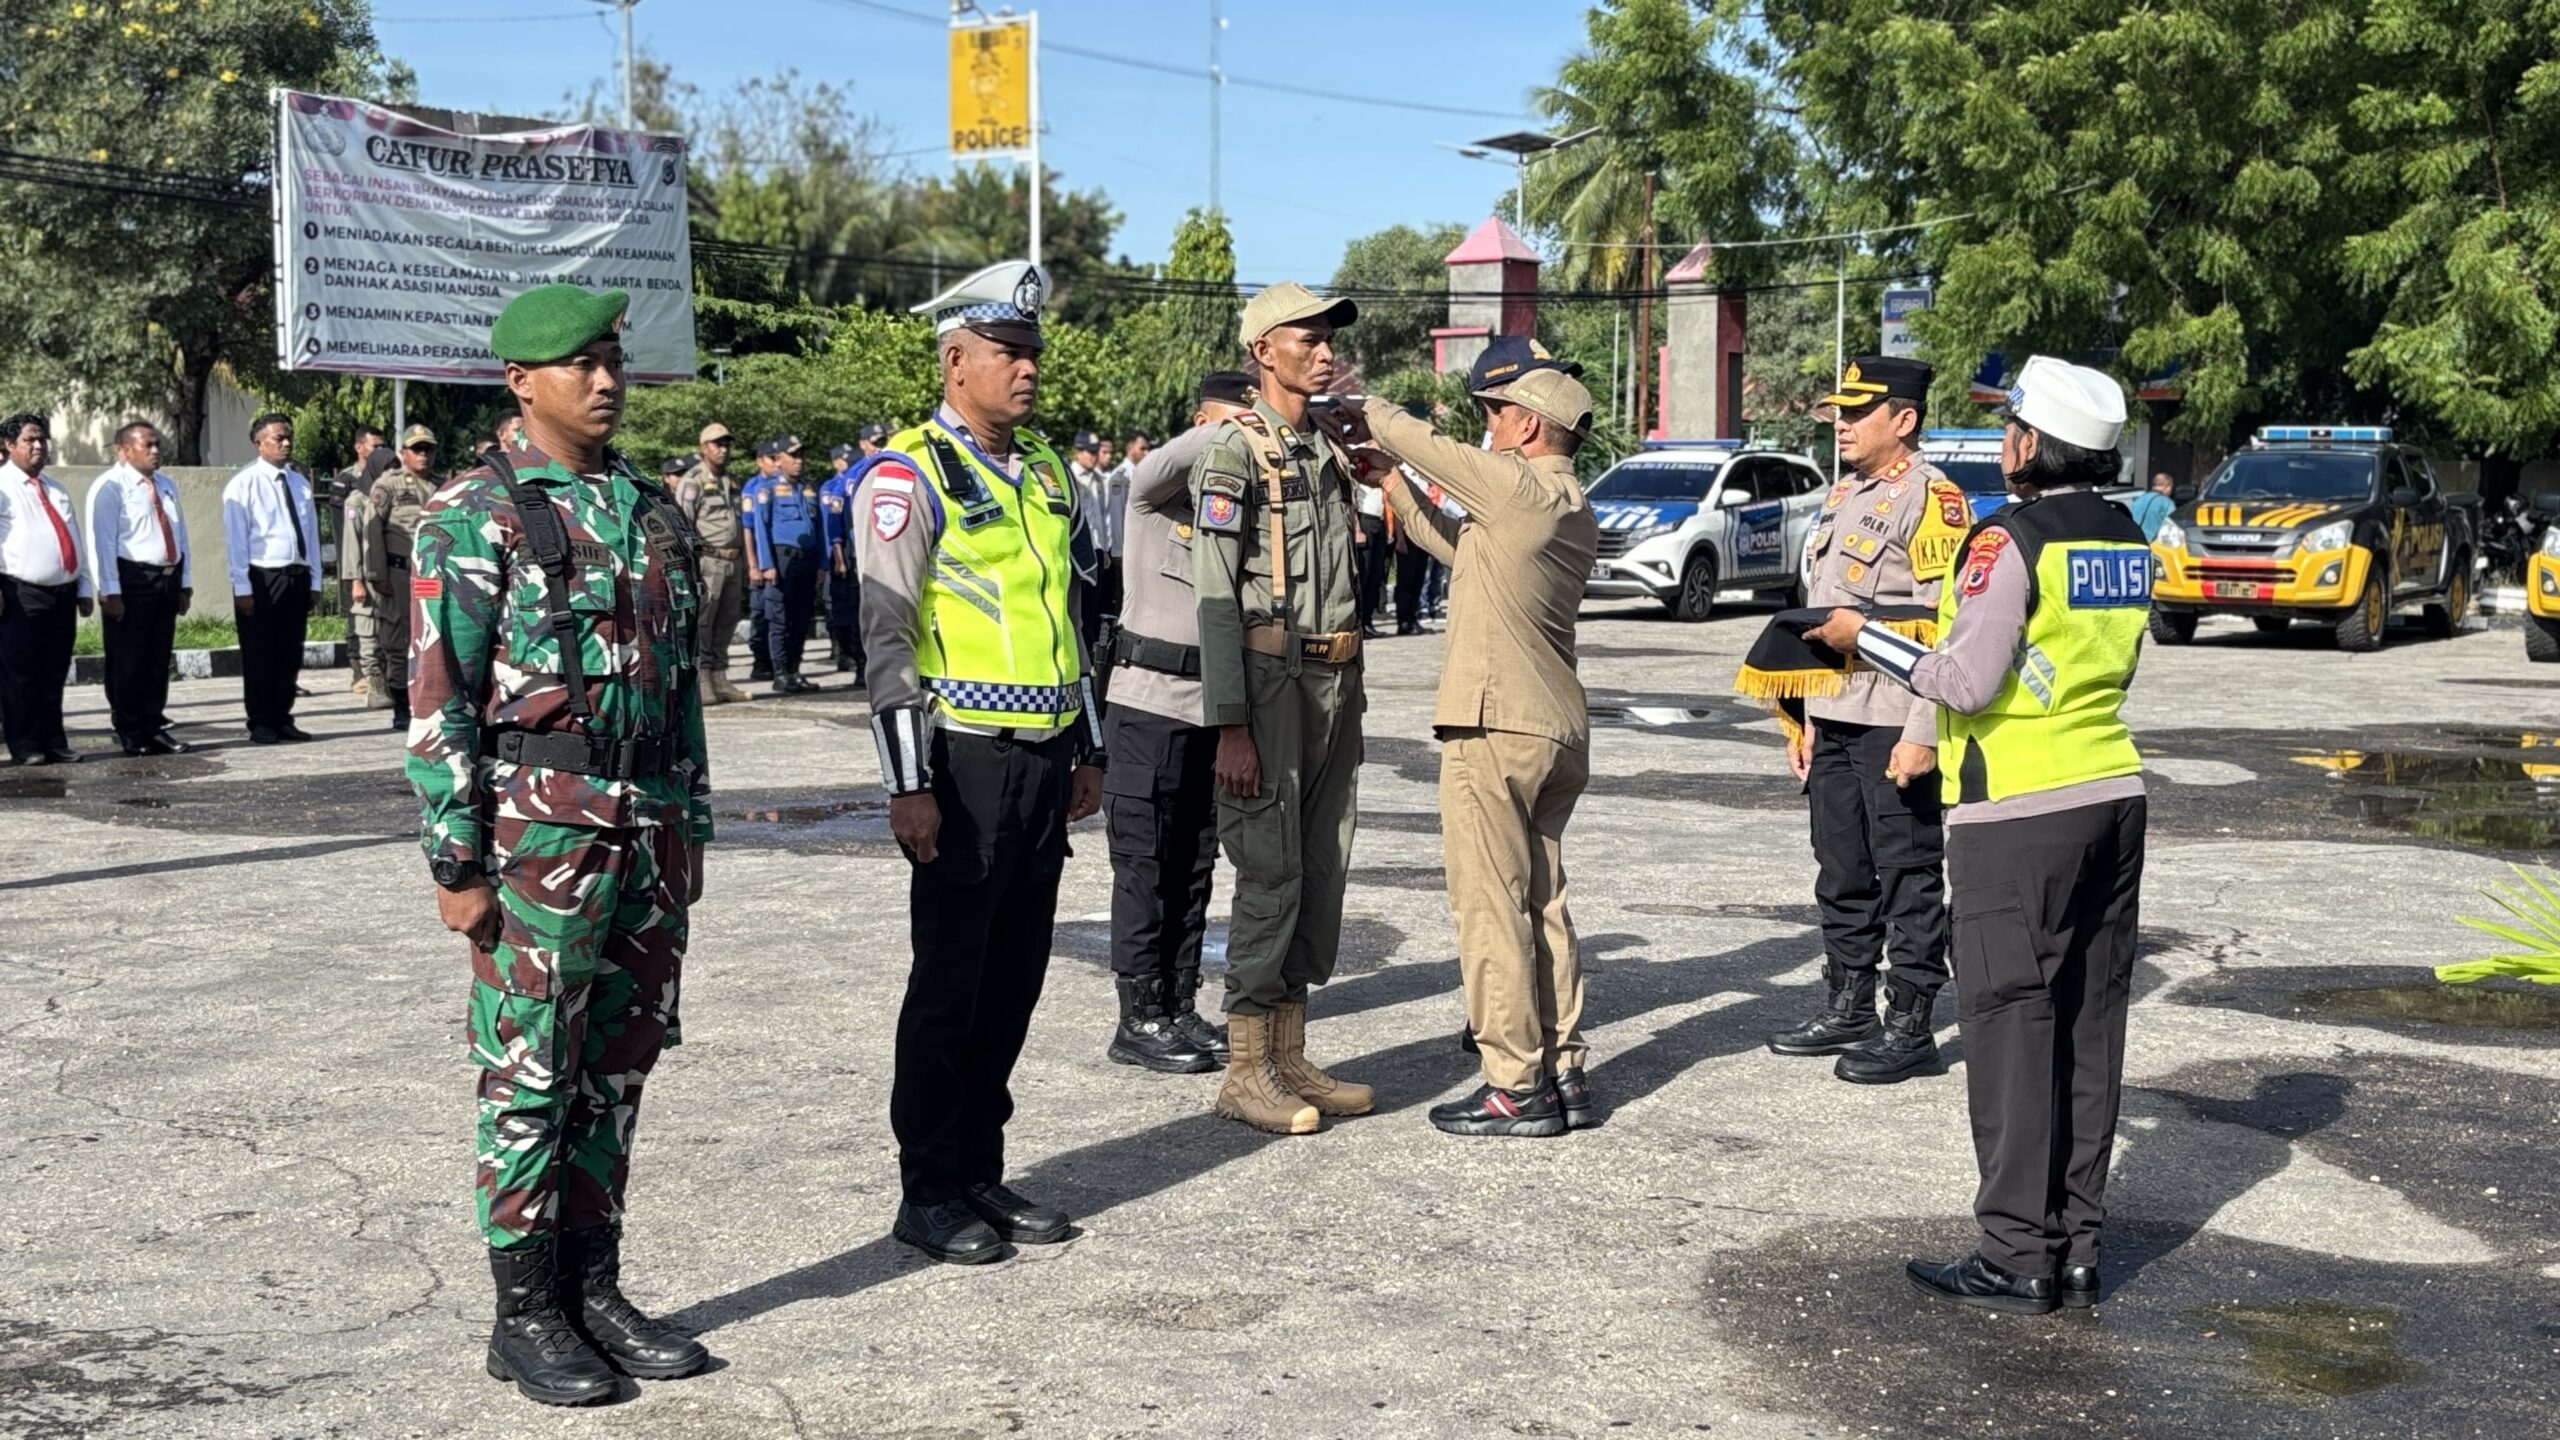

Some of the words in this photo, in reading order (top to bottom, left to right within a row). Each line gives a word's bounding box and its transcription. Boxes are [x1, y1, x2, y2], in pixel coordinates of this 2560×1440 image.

[953, 126, 1023, 152] POLICE
[365, 134, 471, 177] CATUR
[480, 152, 637, 187] PRASETYA
[304, 168, 359, 188] SEBAGAI
[367, 177, 411, 194] INSAN
[515, 193, 604, 209] KEHORMATAN
[304, 202, 354, 217] UNTUK
[305, 184, 392, 206] BERKORBAN
[394, 195, 431, 211] DEMI
[578, 211, 605, 223] DAN
[324, 225, 424, 247] MENIADAKAN
[425, 236, 483, 252] SEGALA
[485, 240, 538, 255] BENTUK
[323, 257, 398, 275] MENJAGA
[403, 263, 510, 283] KESELAMATAN
[602, 274, 642, 289] HARTA
[324, 273, 355, 288] DAN
[356, 276, 389, 291] HAK
[391, 280, 433, 295] ASASI
[325, 305, 402, 323] MENJAMIN
[404, 310, 483, 327] KEPASTIAN
[326, 341, 424, 357] MEMELIHARA
[1750, 530, 1781, 549] POLISI
[1920, 538, 1938, 567] KA
[1941, 537, 1960, 565] OP
[2221, 533, 2262, 543] ISUZU
[2071, 557, 2151, 598] POLISI
